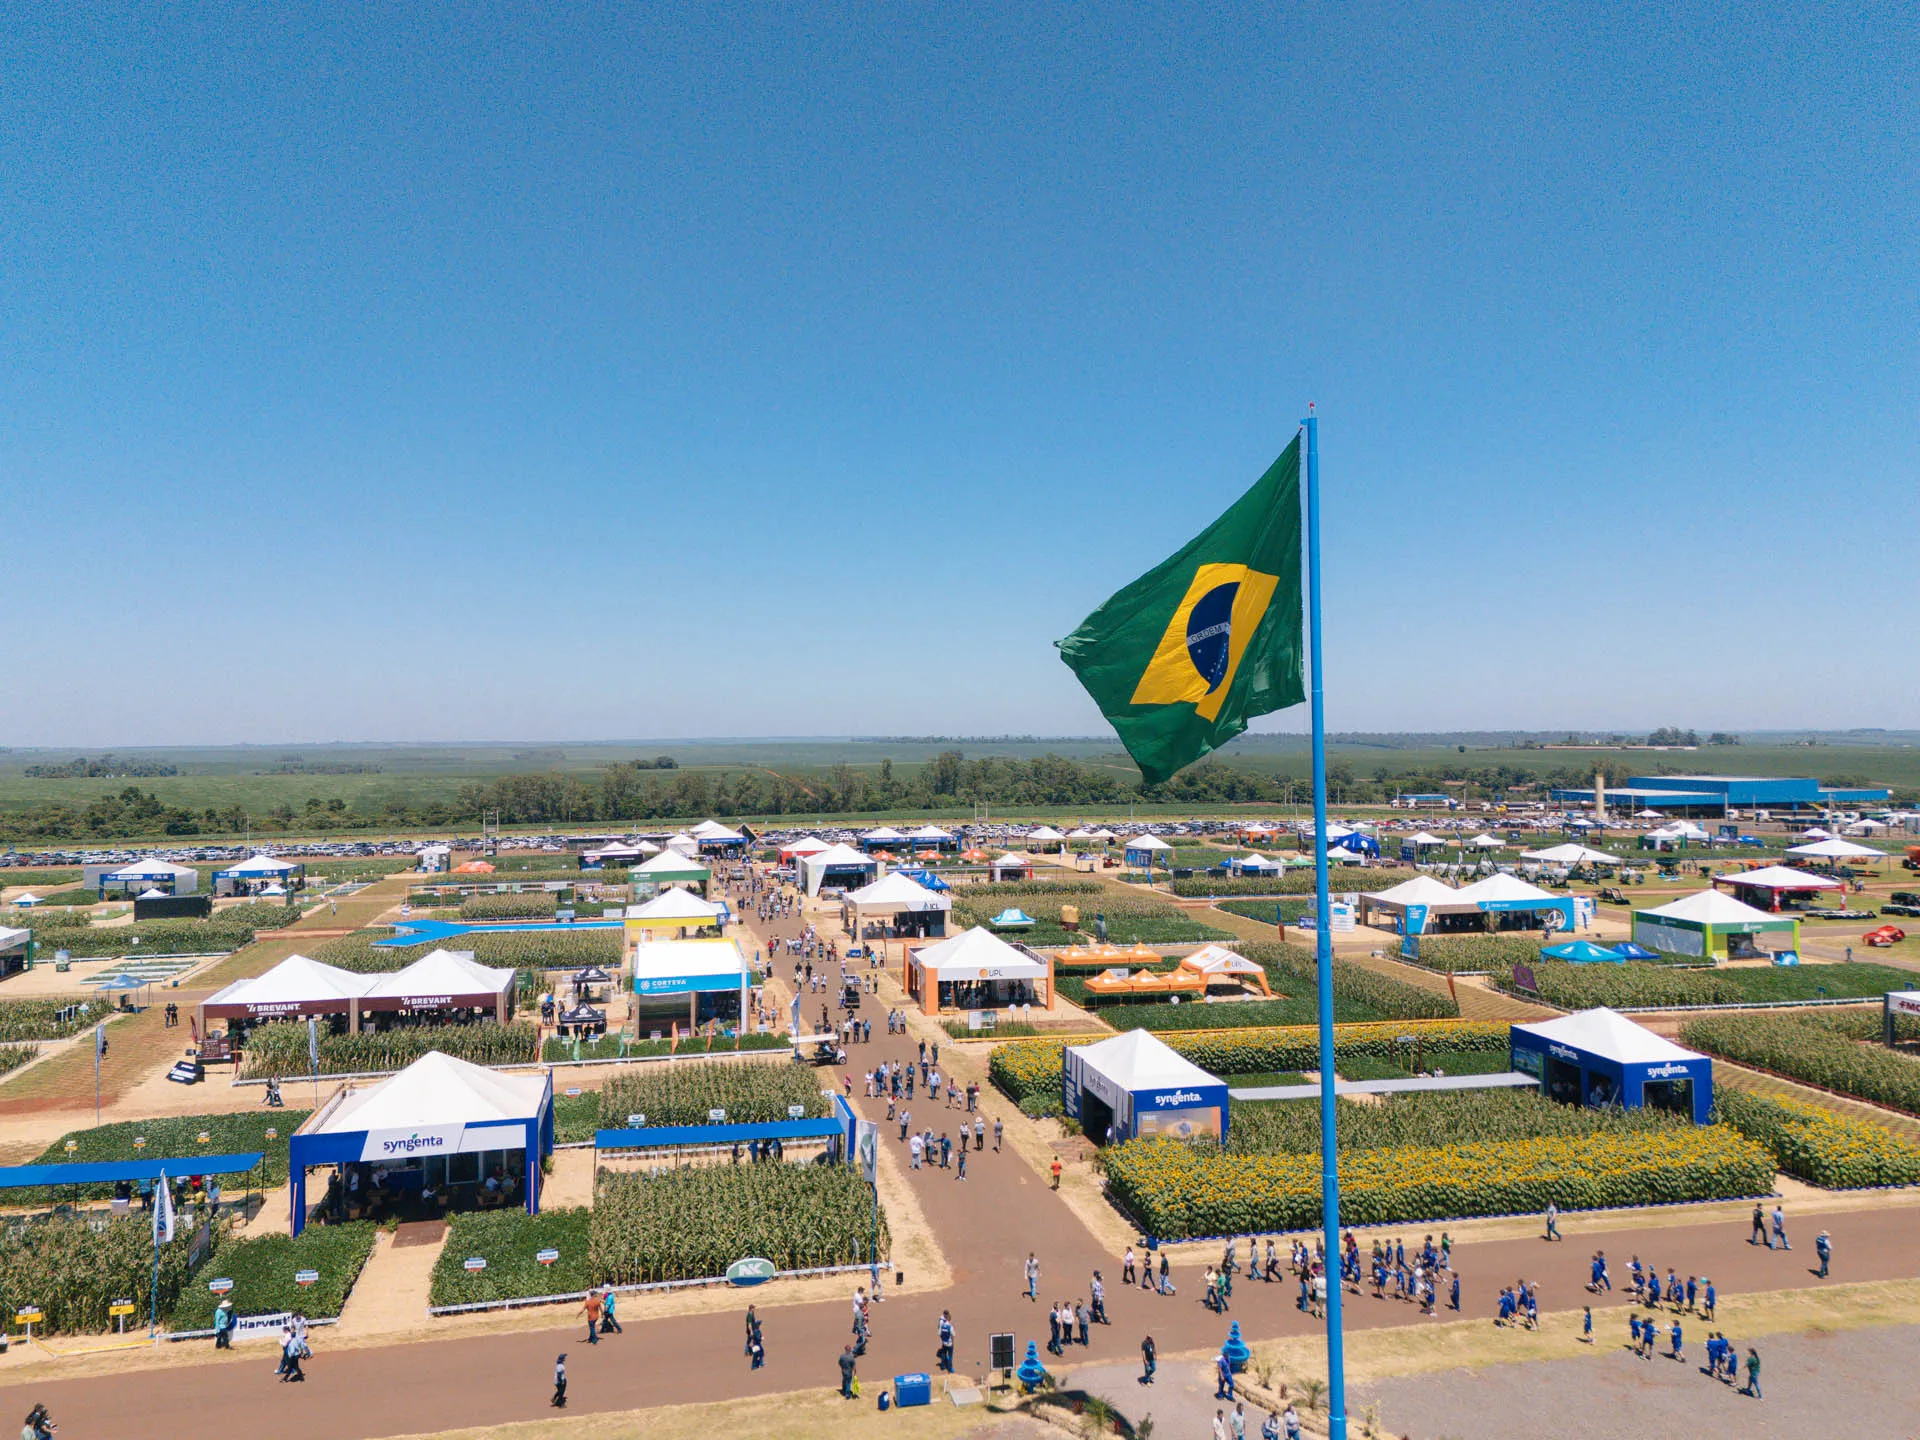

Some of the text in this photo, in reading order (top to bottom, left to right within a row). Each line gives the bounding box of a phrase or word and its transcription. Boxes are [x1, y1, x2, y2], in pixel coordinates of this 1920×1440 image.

[1191, 625, 1222, 642] ORDEM
[989, 969, 1003, 977] UPL
[257, 1003, 301, 1012] BREVANT
[411, 996, 452, 1005] BREVANT
[1550, 1044, 1579, 1060] syngenta
[1647, 1062, 1689, 1078] syngenta
[1155, 1090, 1202, 1106] syngenta
[383, 1133, 443, 1153] syngenta
[739, 1262, 764, 1276] NK
[239, 1316, 288, 1330] Harvest
